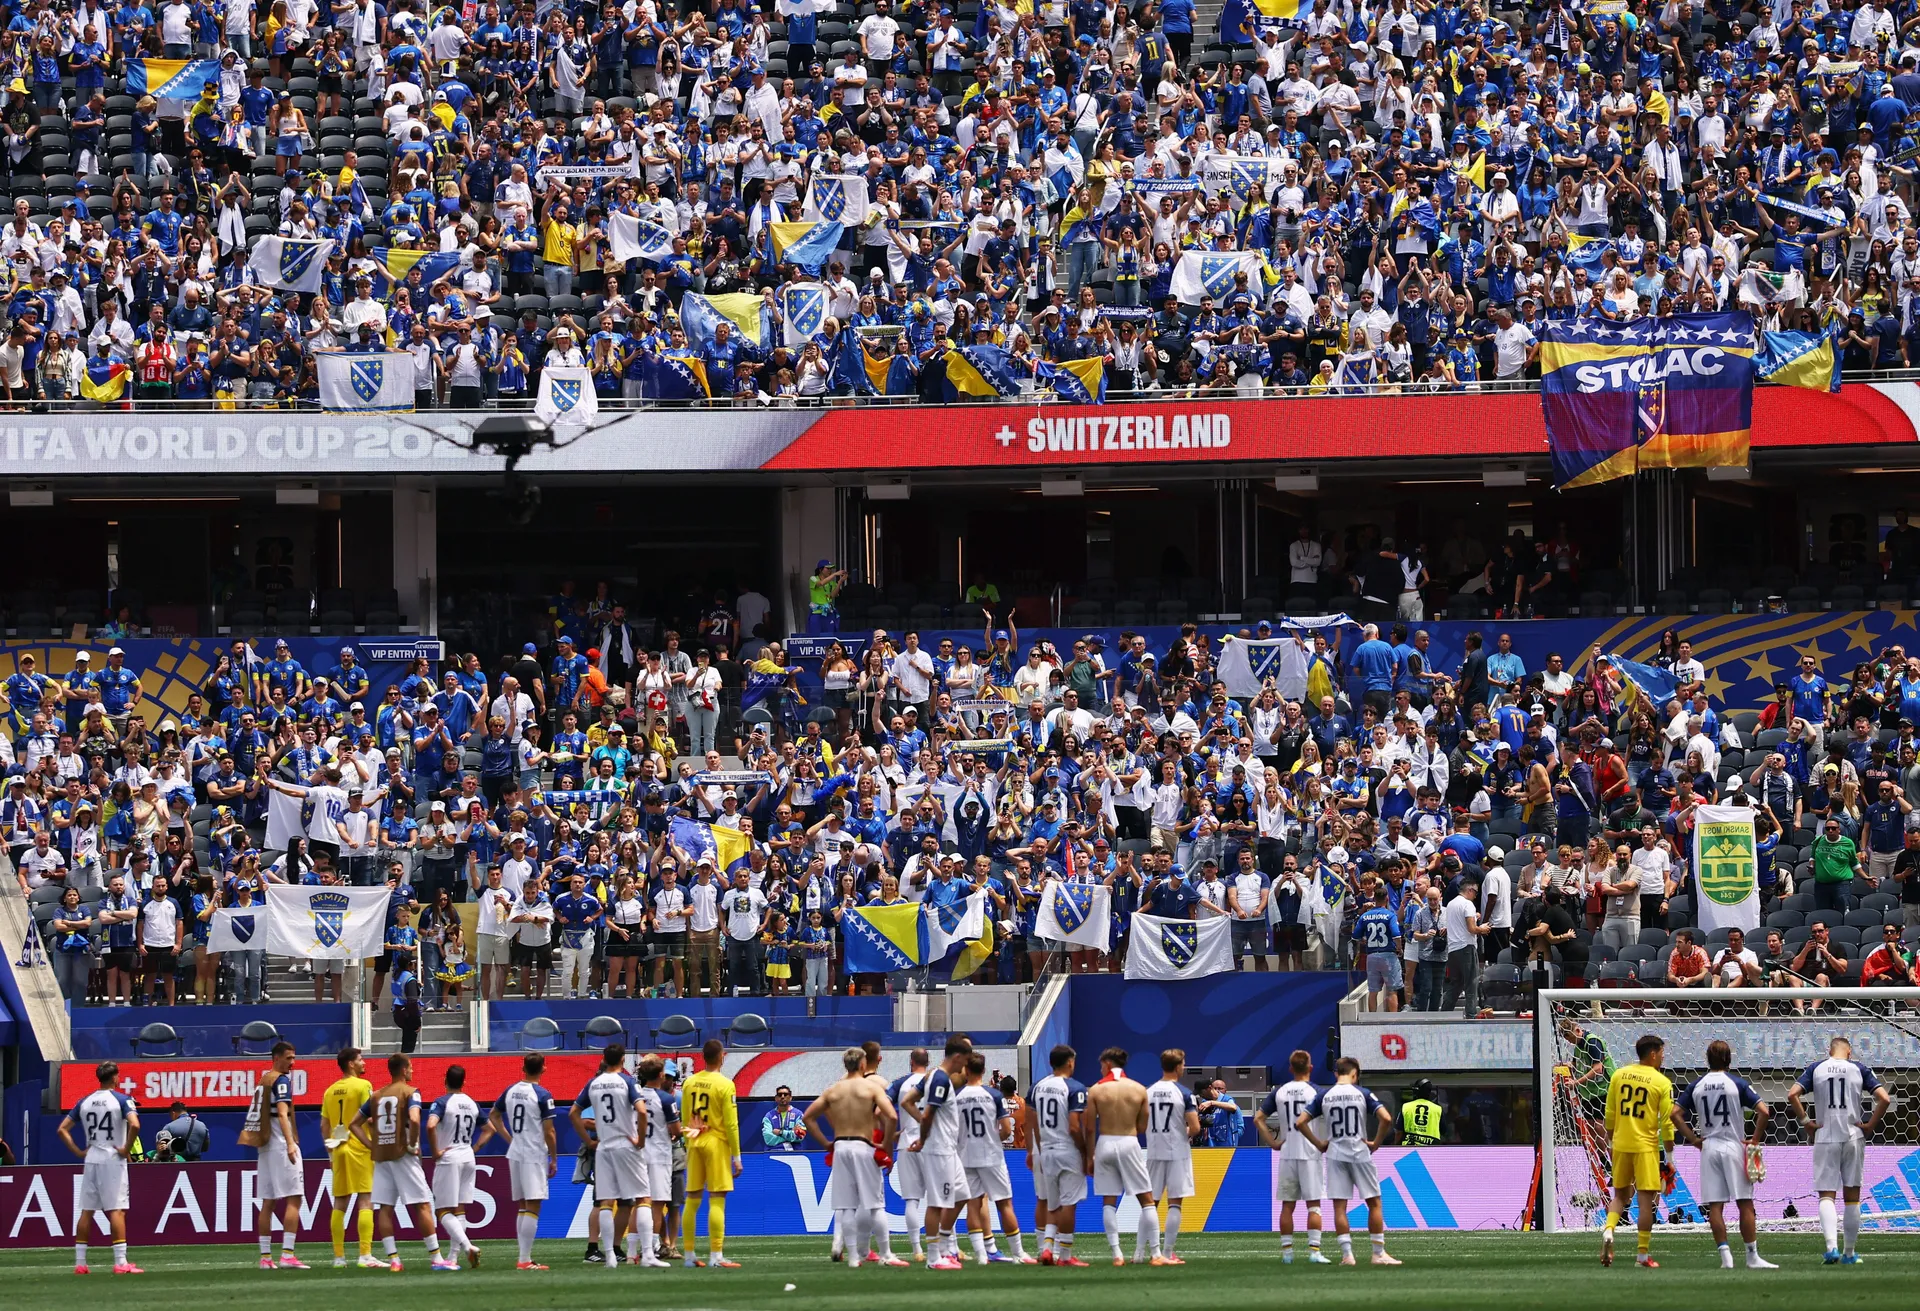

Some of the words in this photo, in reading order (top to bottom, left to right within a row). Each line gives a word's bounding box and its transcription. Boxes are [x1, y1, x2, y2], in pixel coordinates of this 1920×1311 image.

[1146, 41, 1159, 60] 11
[1575, 346, 1725, 394] STOLAC
[0, 426, 76, 461] IFA
[83, 426, 248, 461] WORLD
[256, 426, 344, 460] CUP
[1028, 414, 1231, 453] SWITZERLAND
[711, 618, 727, 635] 21
[717, 609, 733, 620] ANGELES
[371, 650, 386, 659] VIP
[388, 649, 418, 659] ENTRY
[419, 649, 428, 658] 11
[799, 647, 815, 655] VIP
[1510, 713, 1525, 732] 11
[326, 799, 341, 819] 10
[311, 893, 348, 904] ARMIJA
[1366, 922, 1387, 948] 23
[144, 1070, 308, 1099] SWITZERLD
[1826, 1077, 1847, 1110] 11
[337, 1099, 344, 1126] 1
[601, 1093, 616, 1123] 3
[691, 1091, 709, 1122] 12
[1038, 1096, 1059, 1129] 19
[1620, 1084, 1648, 1119] 22
[1701, 1094, 1730, 1128] 14
[86, 1111, 114, 1141] 24
[453, 1114, 473, 1144] 13
[512, 1104, 525, 1134] 8
[961, 1107, 986, 1138] 16
[1150, 1102, 1174, 1133] 17
[1329, 1105, 1359, 1138] 20
[943, 1182, 950, 1196] 6
